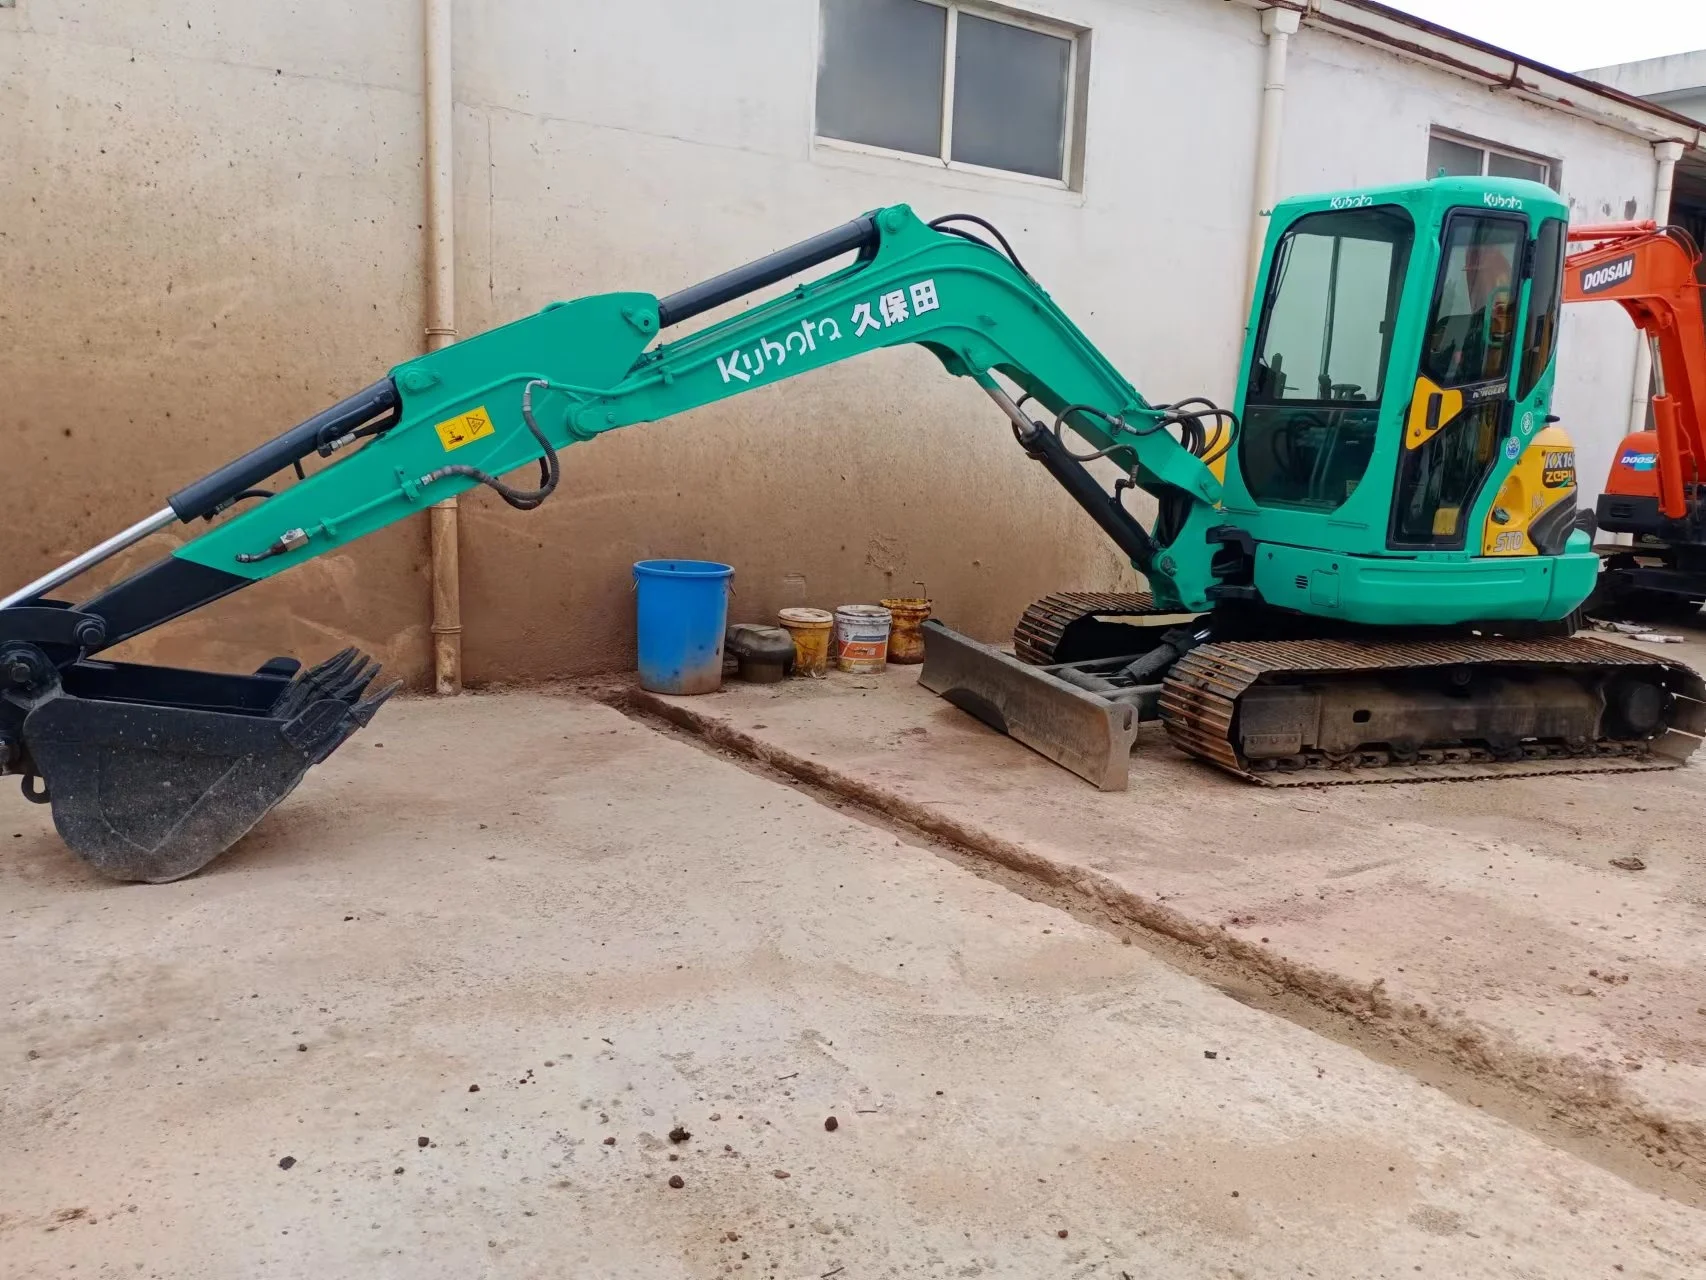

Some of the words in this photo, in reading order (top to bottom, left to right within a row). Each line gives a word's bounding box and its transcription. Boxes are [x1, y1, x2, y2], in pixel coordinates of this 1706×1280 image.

[1330, 194, 1373, 209] Kubota
[1483, 192, 1522, 210] Kubota
[1583, 259, 1633, 291] DOOSAN
[716, 317, 843, 384] Kubota
[850, 278, 940, 338] 久保田
